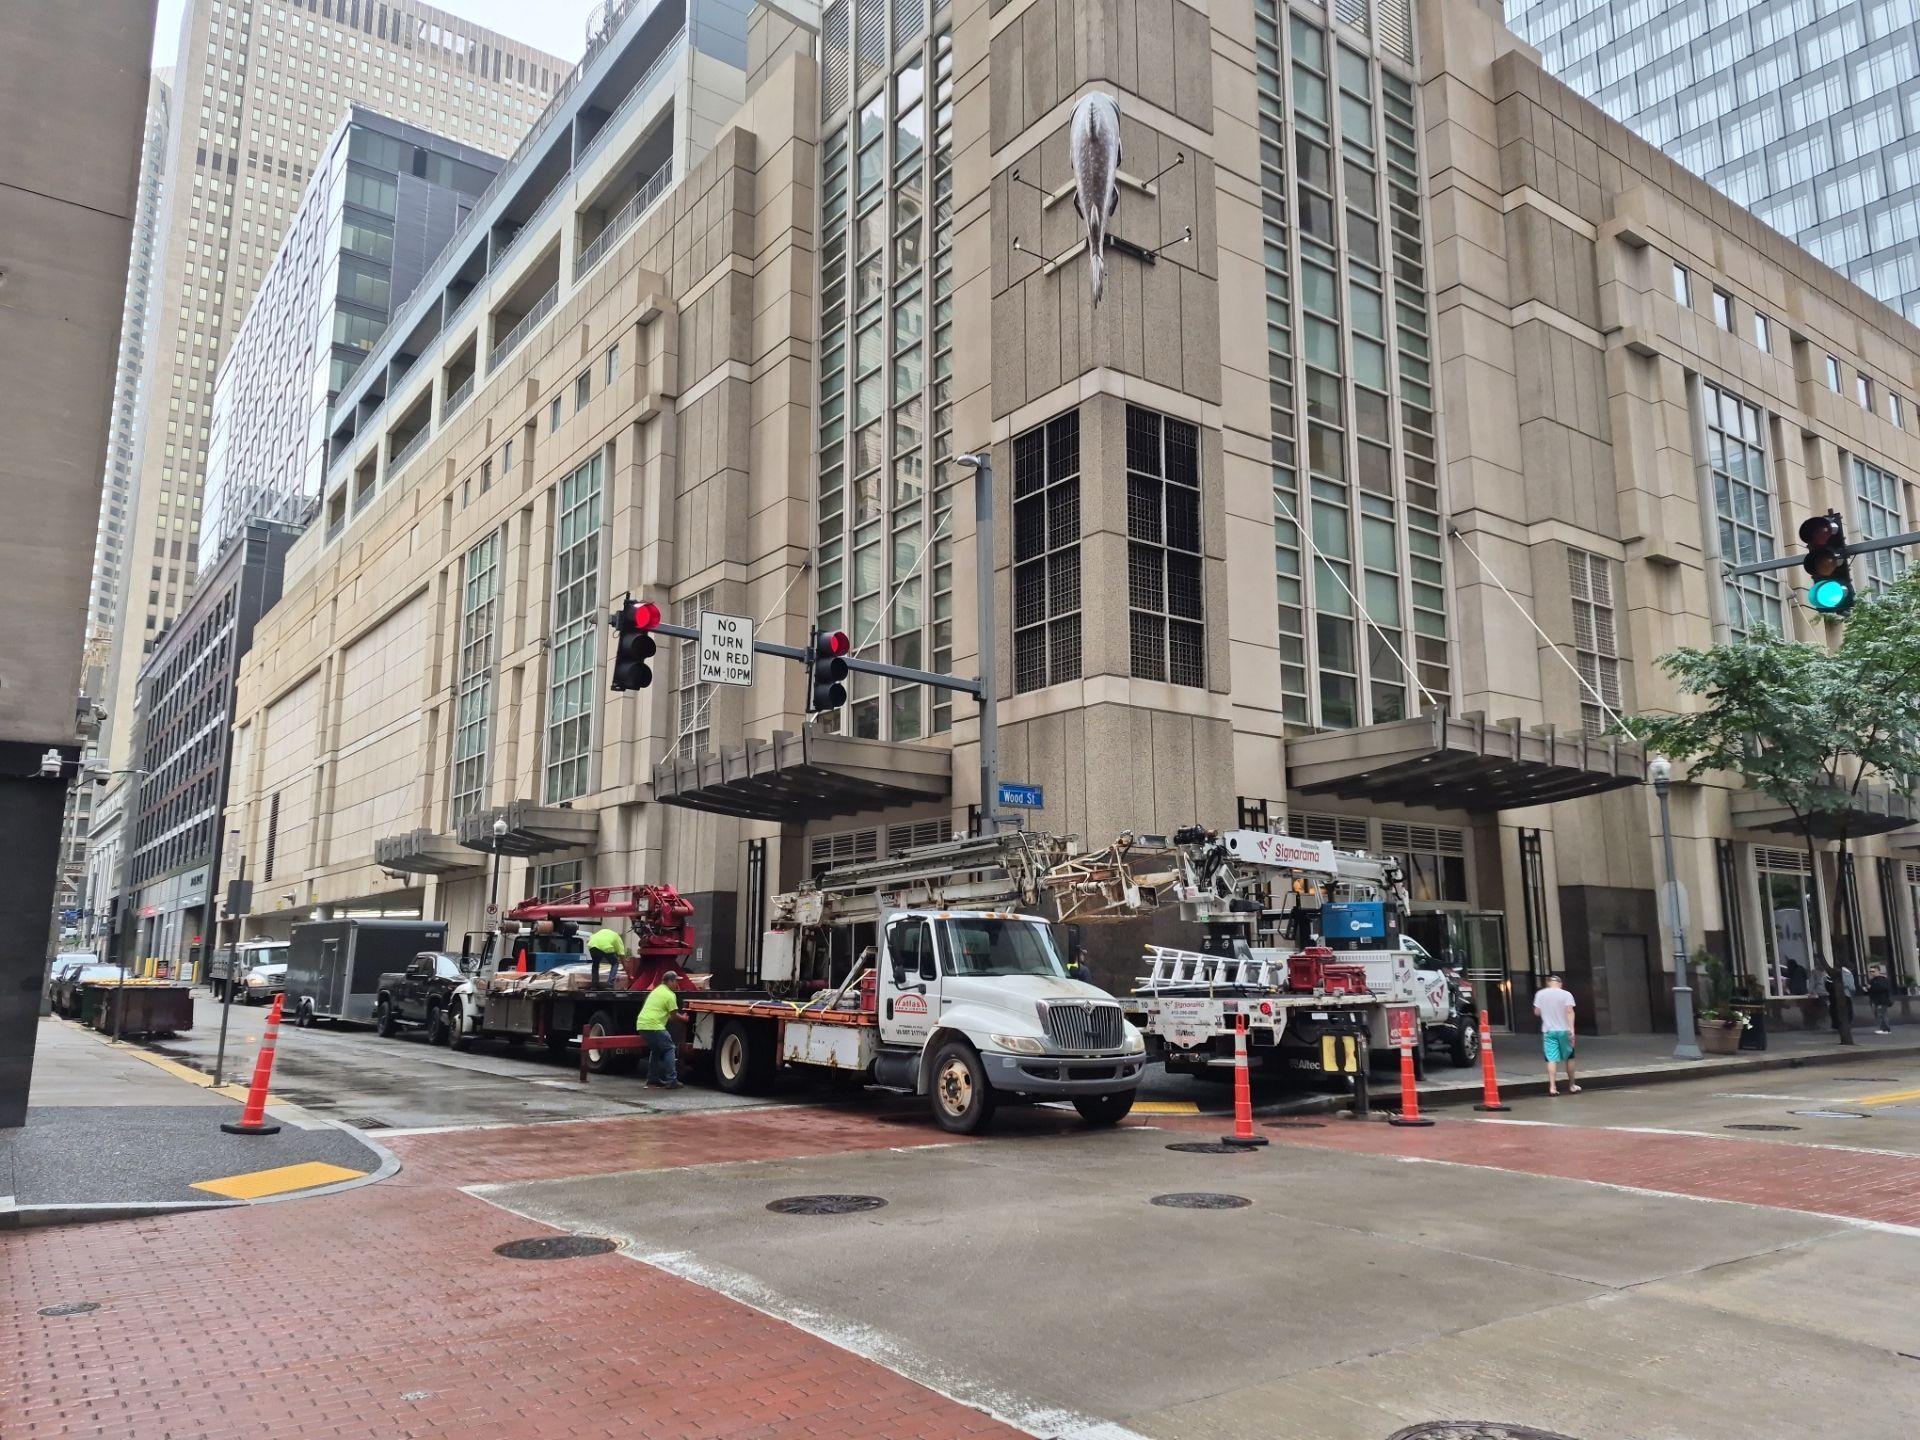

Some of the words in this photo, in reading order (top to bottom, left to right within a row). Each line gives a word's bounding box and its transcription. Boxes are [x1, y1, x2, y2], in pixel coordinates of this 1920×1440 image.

[718, 620, 737, 632] NO
[712, 635, 743, 649] TURN
[704, 649, 720, 661] ON
[726, 652, 749, 665] RED
[1004, 790, 1023, 803] Wood
[1027, 793, 1035, 805] St
[1275, 843, 1319, 862] Signarama
[902, 1000, 920, 1008] atlas
[1141, 1001, 1148, 1009] 10
[1298, 1060, 1321, 1070] Altec
